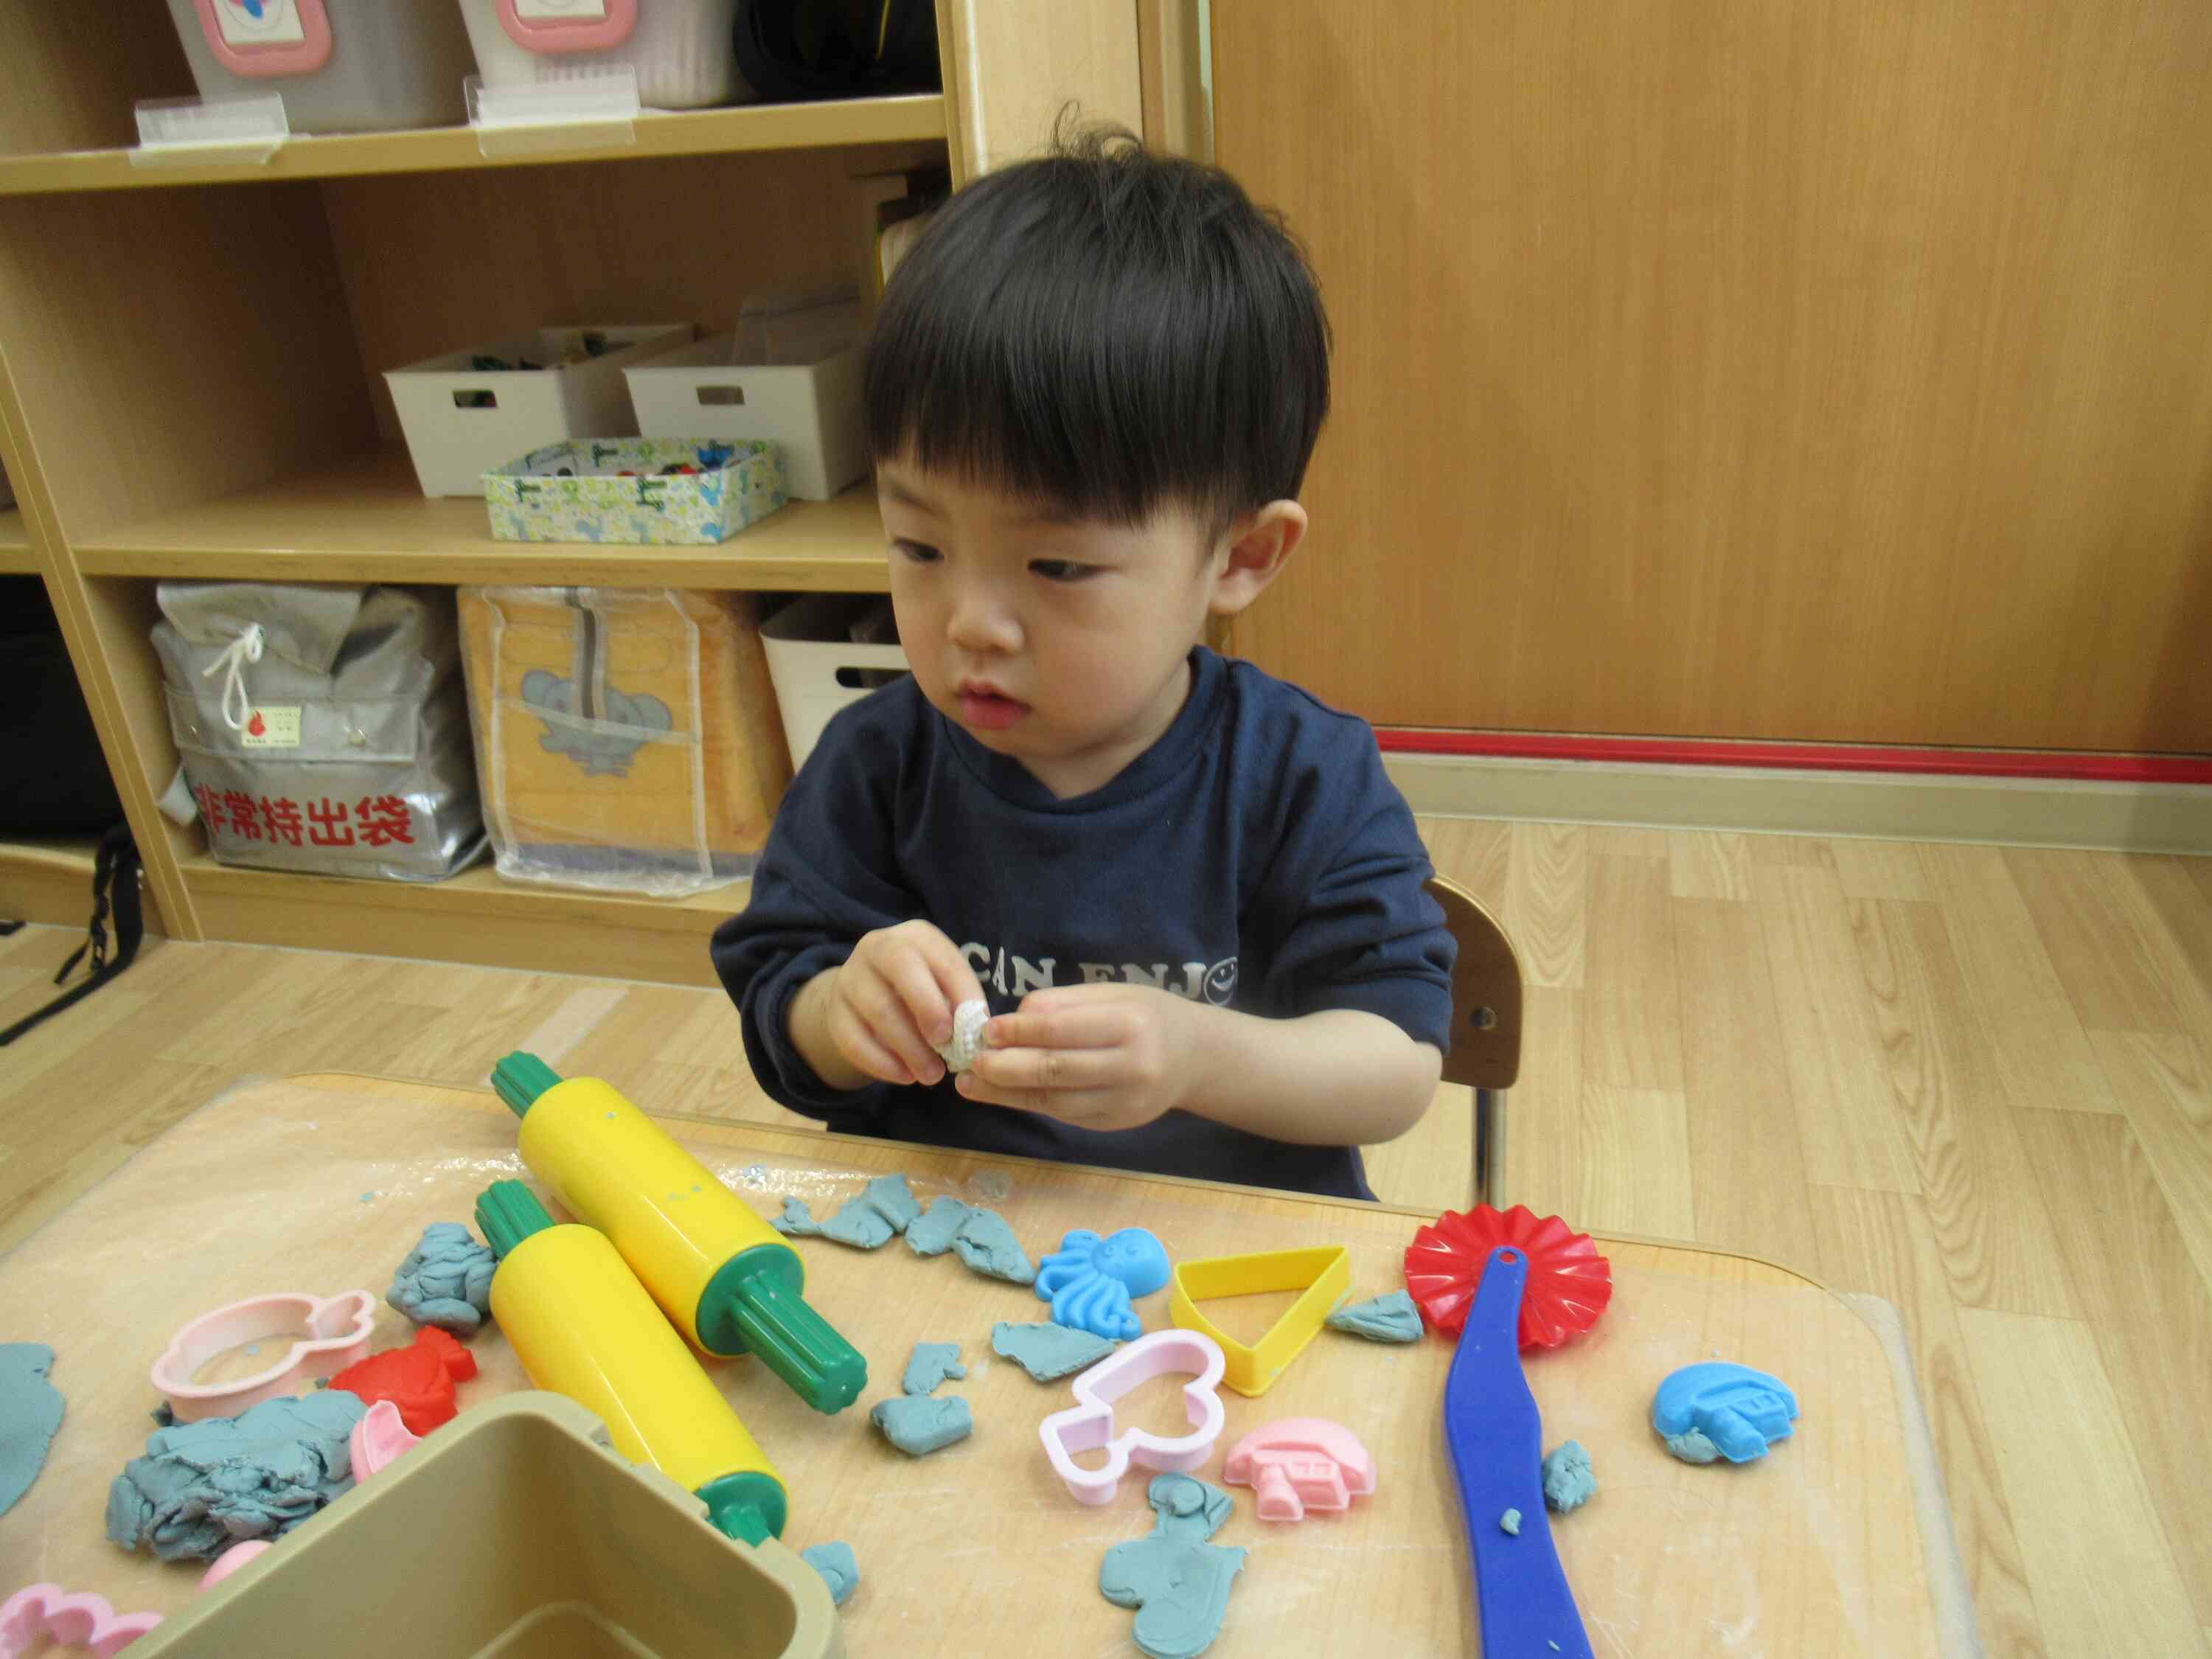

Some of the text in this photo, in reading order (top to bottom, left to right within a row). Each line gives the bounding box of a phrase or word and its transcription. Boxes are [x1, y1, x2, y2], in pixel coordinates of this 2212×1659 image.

[195, 783, 415, 847] 非常持出袋
[960, 942, 1057, 998] CAN
